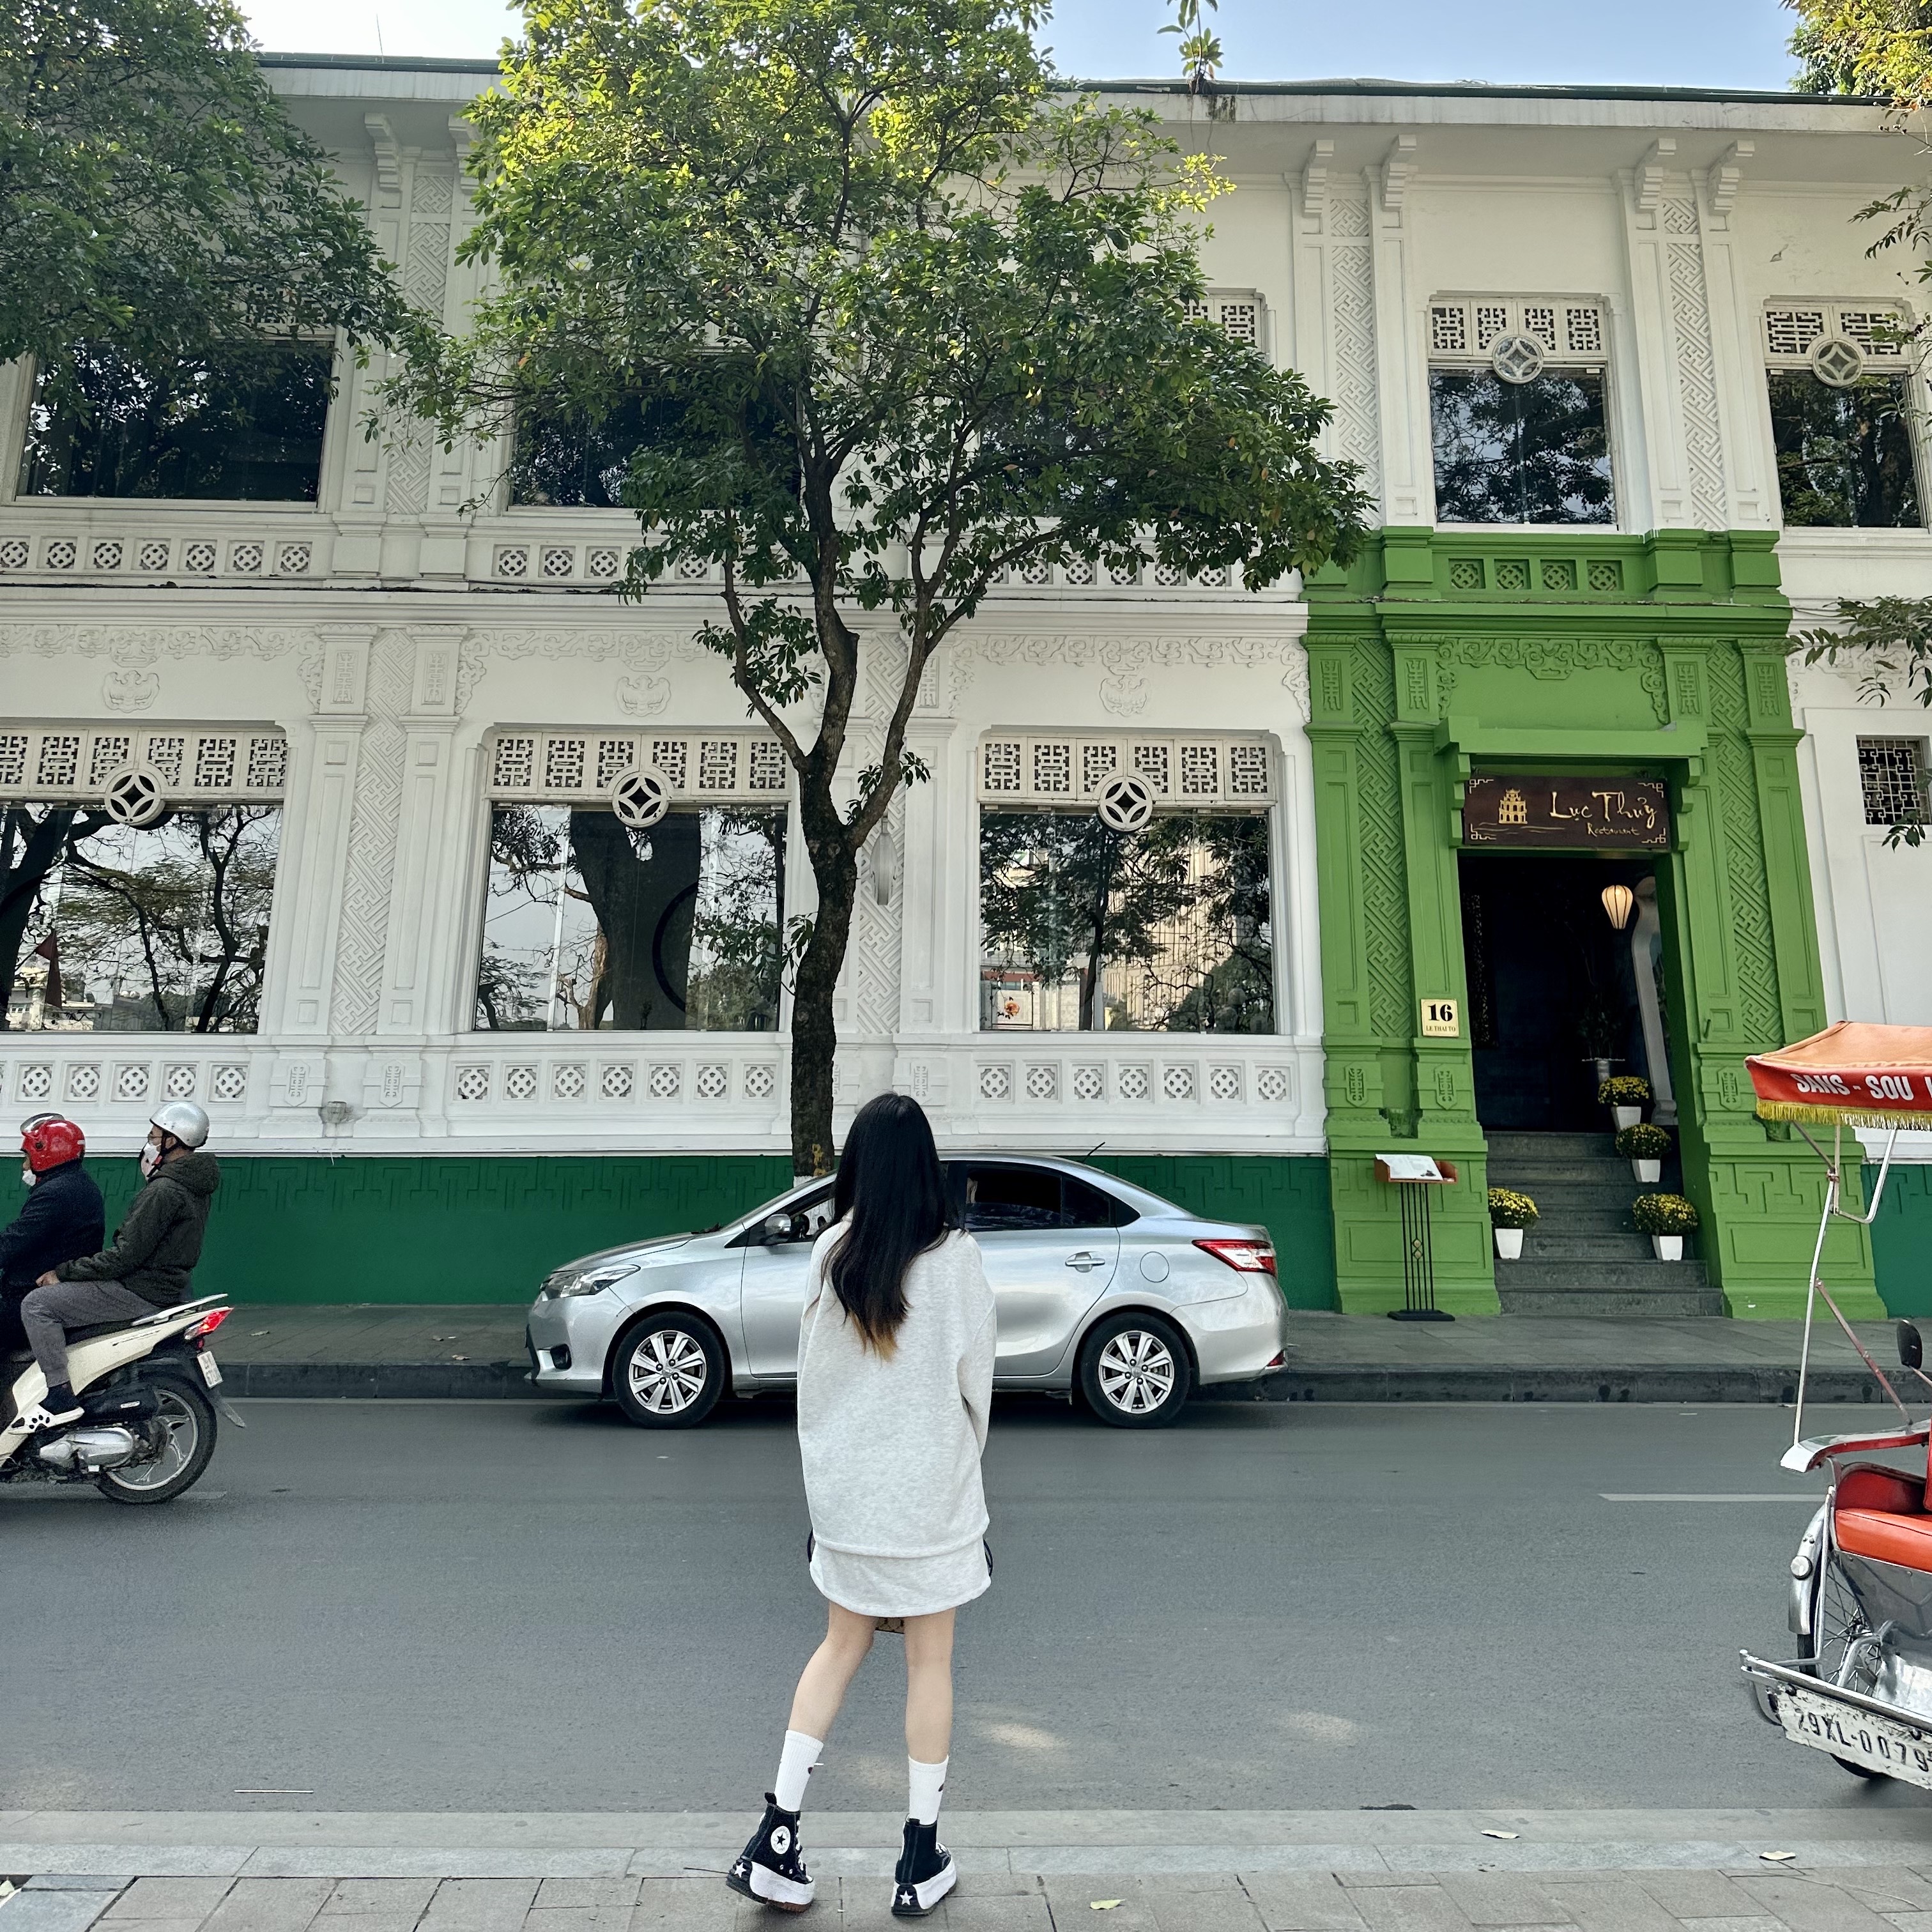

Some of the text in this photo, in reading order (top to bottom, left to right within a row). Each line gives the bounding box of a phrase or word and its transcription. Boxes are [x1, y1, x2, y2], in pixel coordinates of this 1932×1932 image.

[1549, 791, 1592, 821] Lục
[1587, 822, 1640, 837] Restaurant
[1427, 1003, 1453, 1022] 16
[1790, 1073, 1851, 1096] SANS
[1865, 1075, 1914, 1101] SOU
